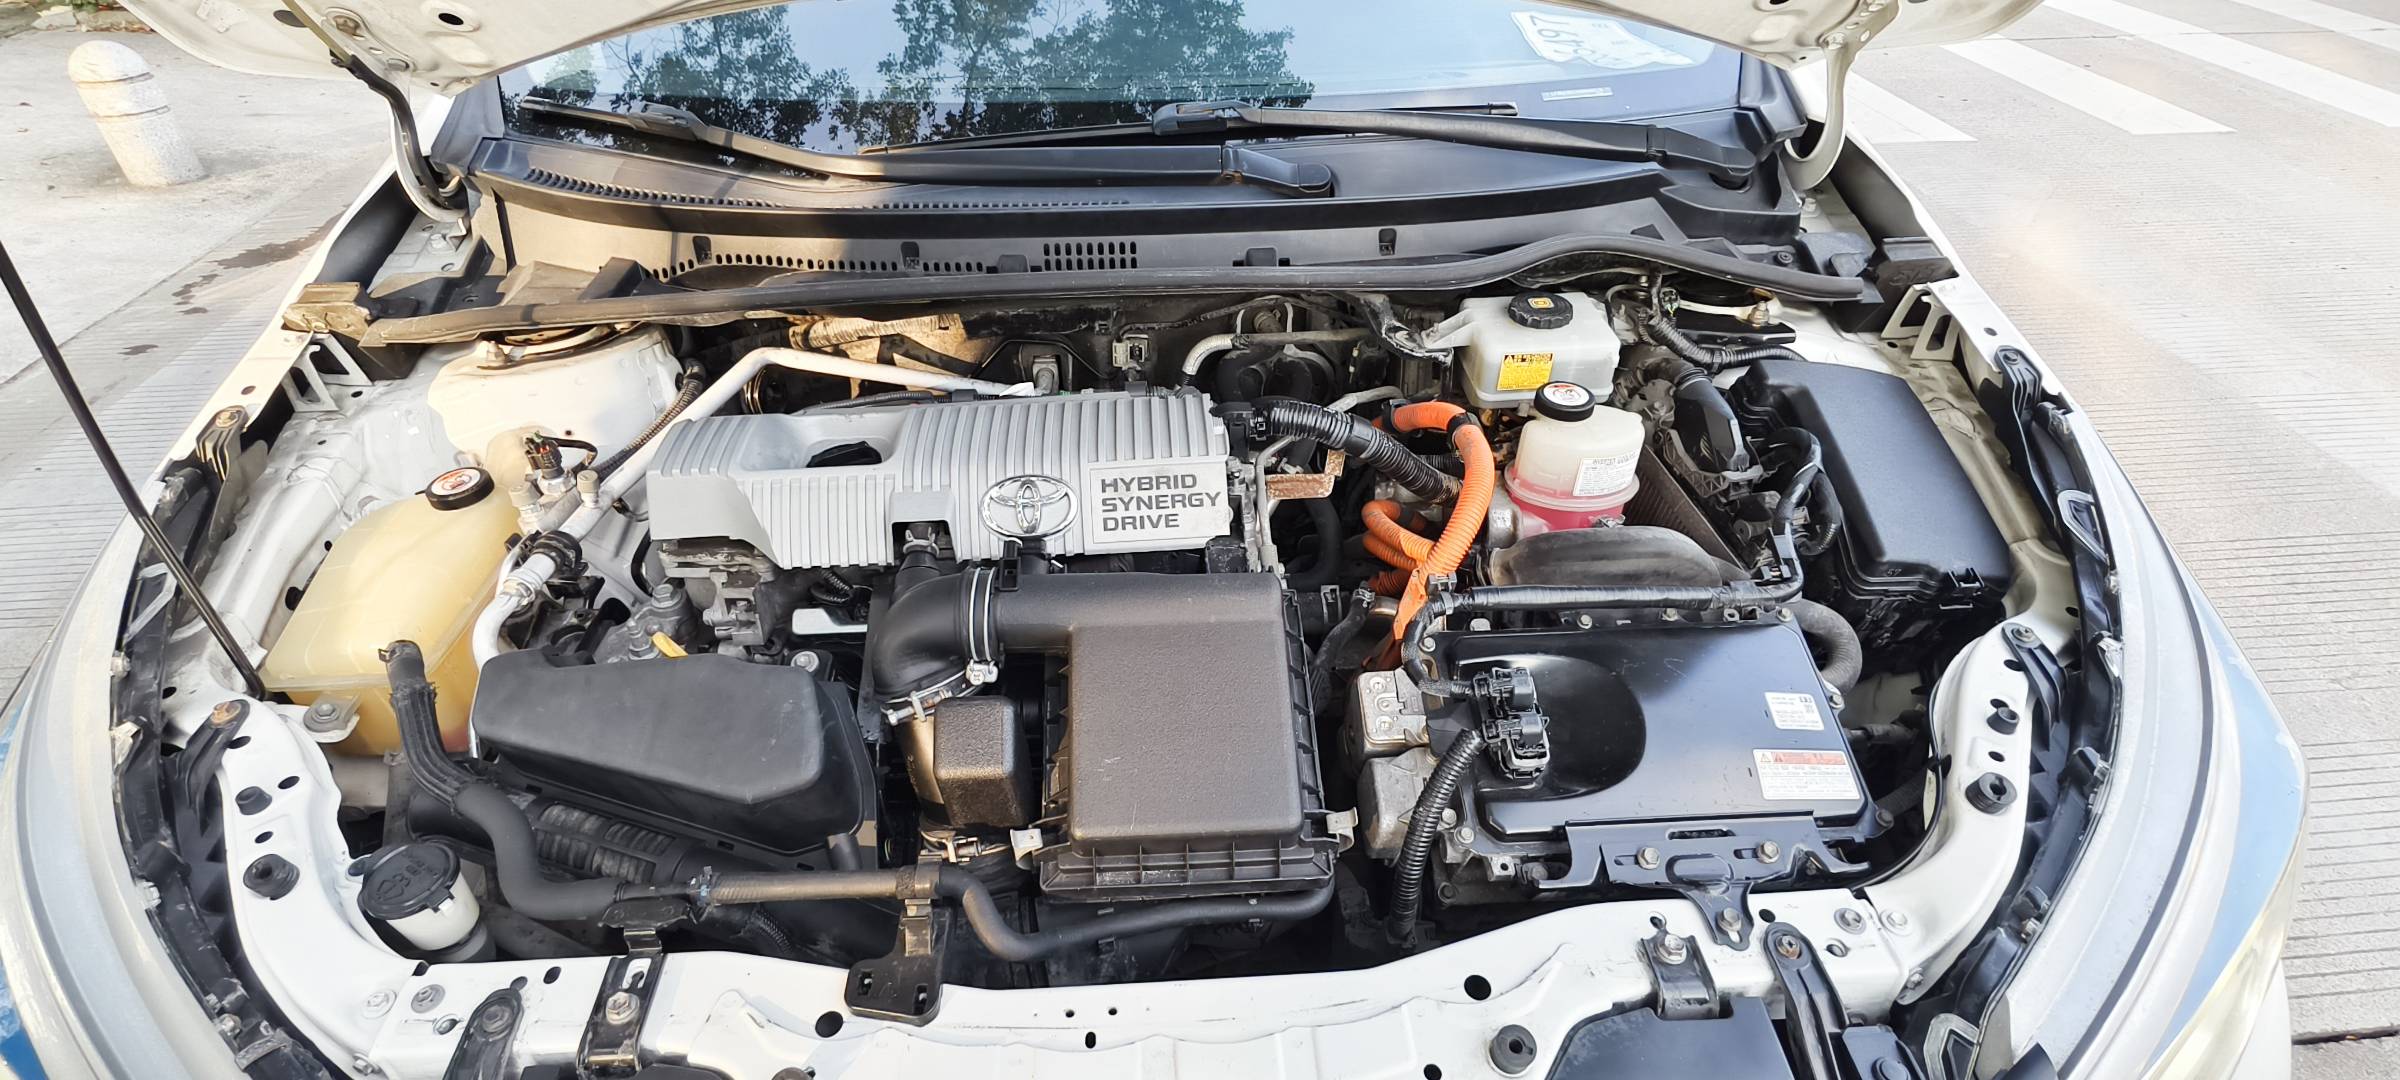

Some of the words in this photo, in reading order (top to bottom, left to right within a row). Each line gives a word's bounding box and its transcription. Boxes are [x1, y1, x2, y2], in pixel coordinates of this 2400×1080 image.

[1101, 474, 1197, 492] HYBRID
[1101, 492, 1221, 513] SYNERGY
[1103, 514, 1179, 531] DRIVE
